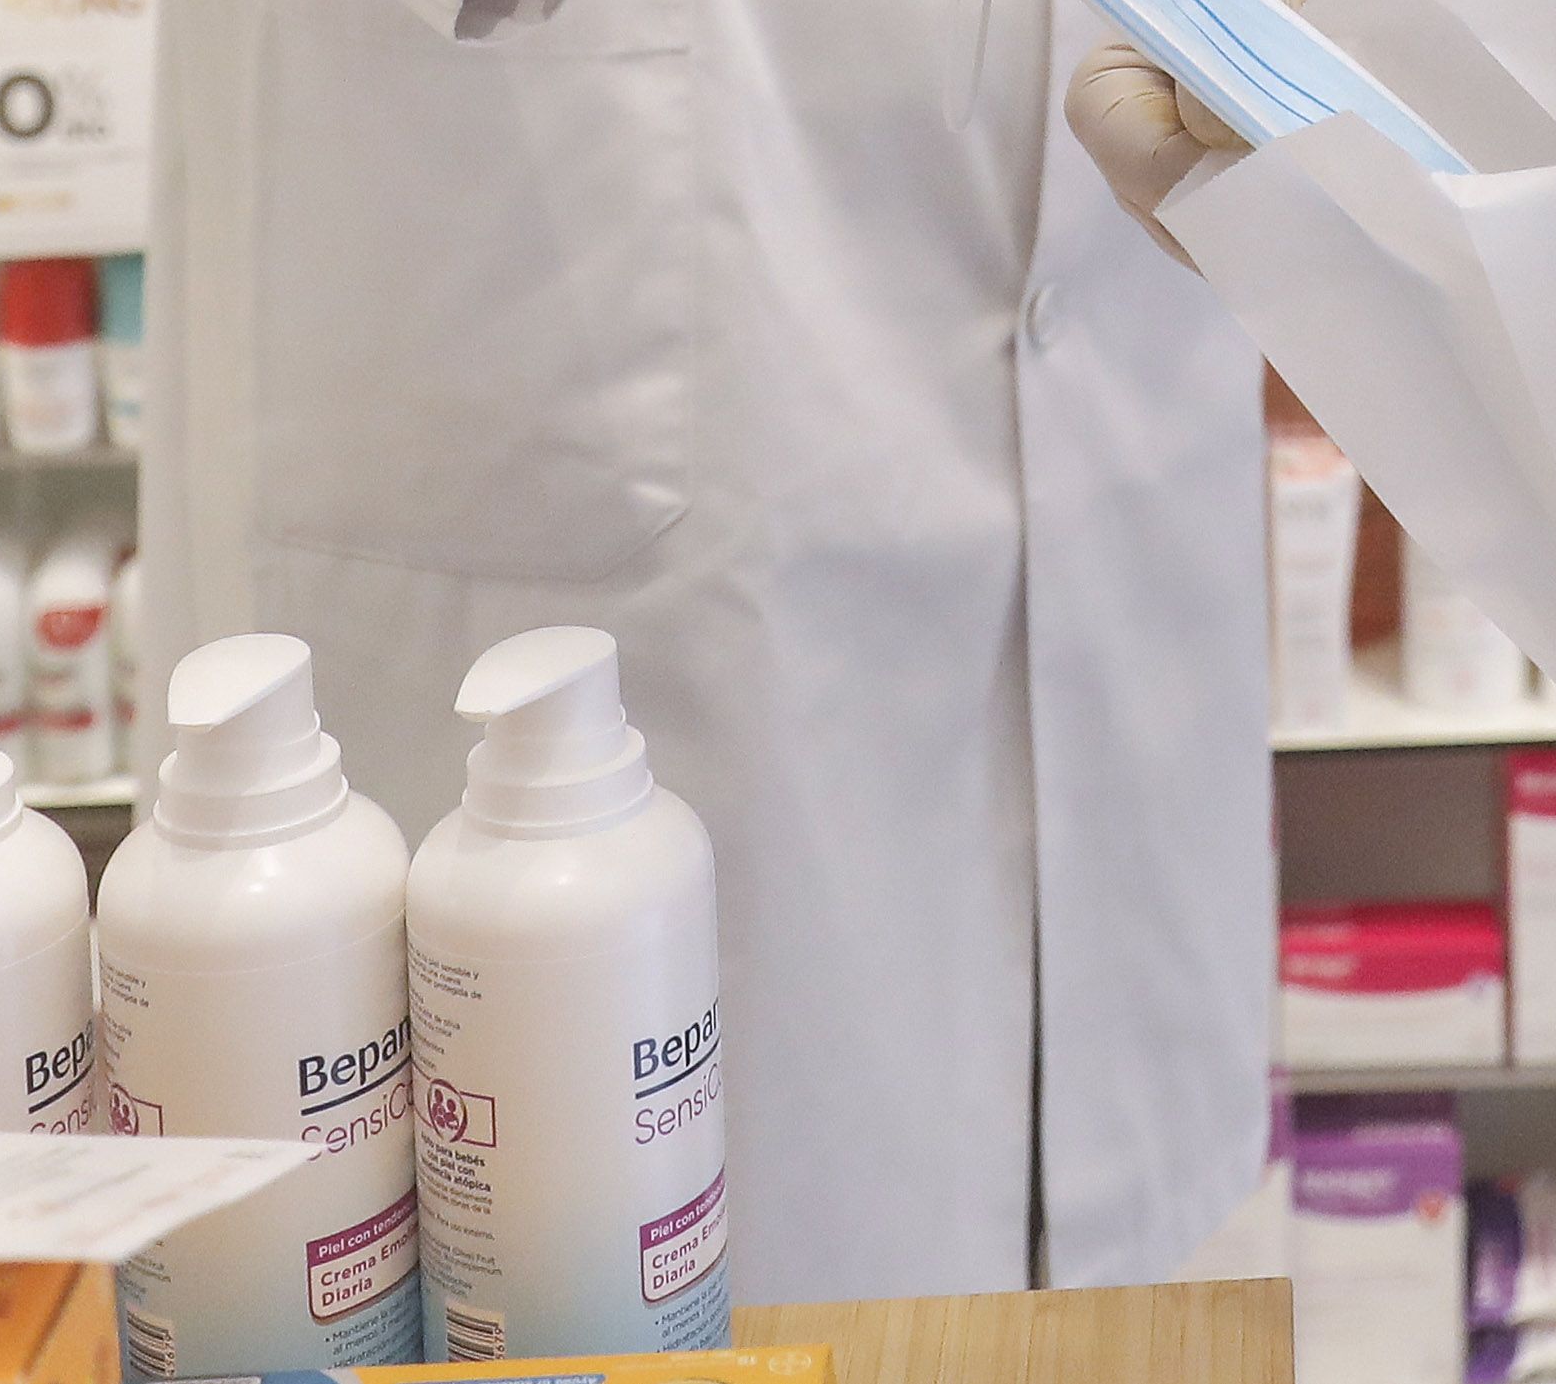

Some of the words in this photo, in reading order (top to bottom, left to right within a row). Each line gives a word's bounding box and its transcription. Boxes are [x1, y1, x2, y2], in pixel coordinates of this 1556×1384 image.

[455, 1149, 486, 1168] bebés
[457, 1164, 476, 1177] con
[454, 1174, 491, 1192] atópica
[650, 1220, 674, 1242] Piel
[675, 1209, 695, 1229] con
[318, 1238, 344, 1258] Piel
[348, 1230, 370, 1247] con
[652, 1236, 699, 1269] Crema
[321, 1256, 376, 1286] Crema
[653, 1258, 696, 1290] Diaria
[322, 1277, 373, 1307] Diaria
